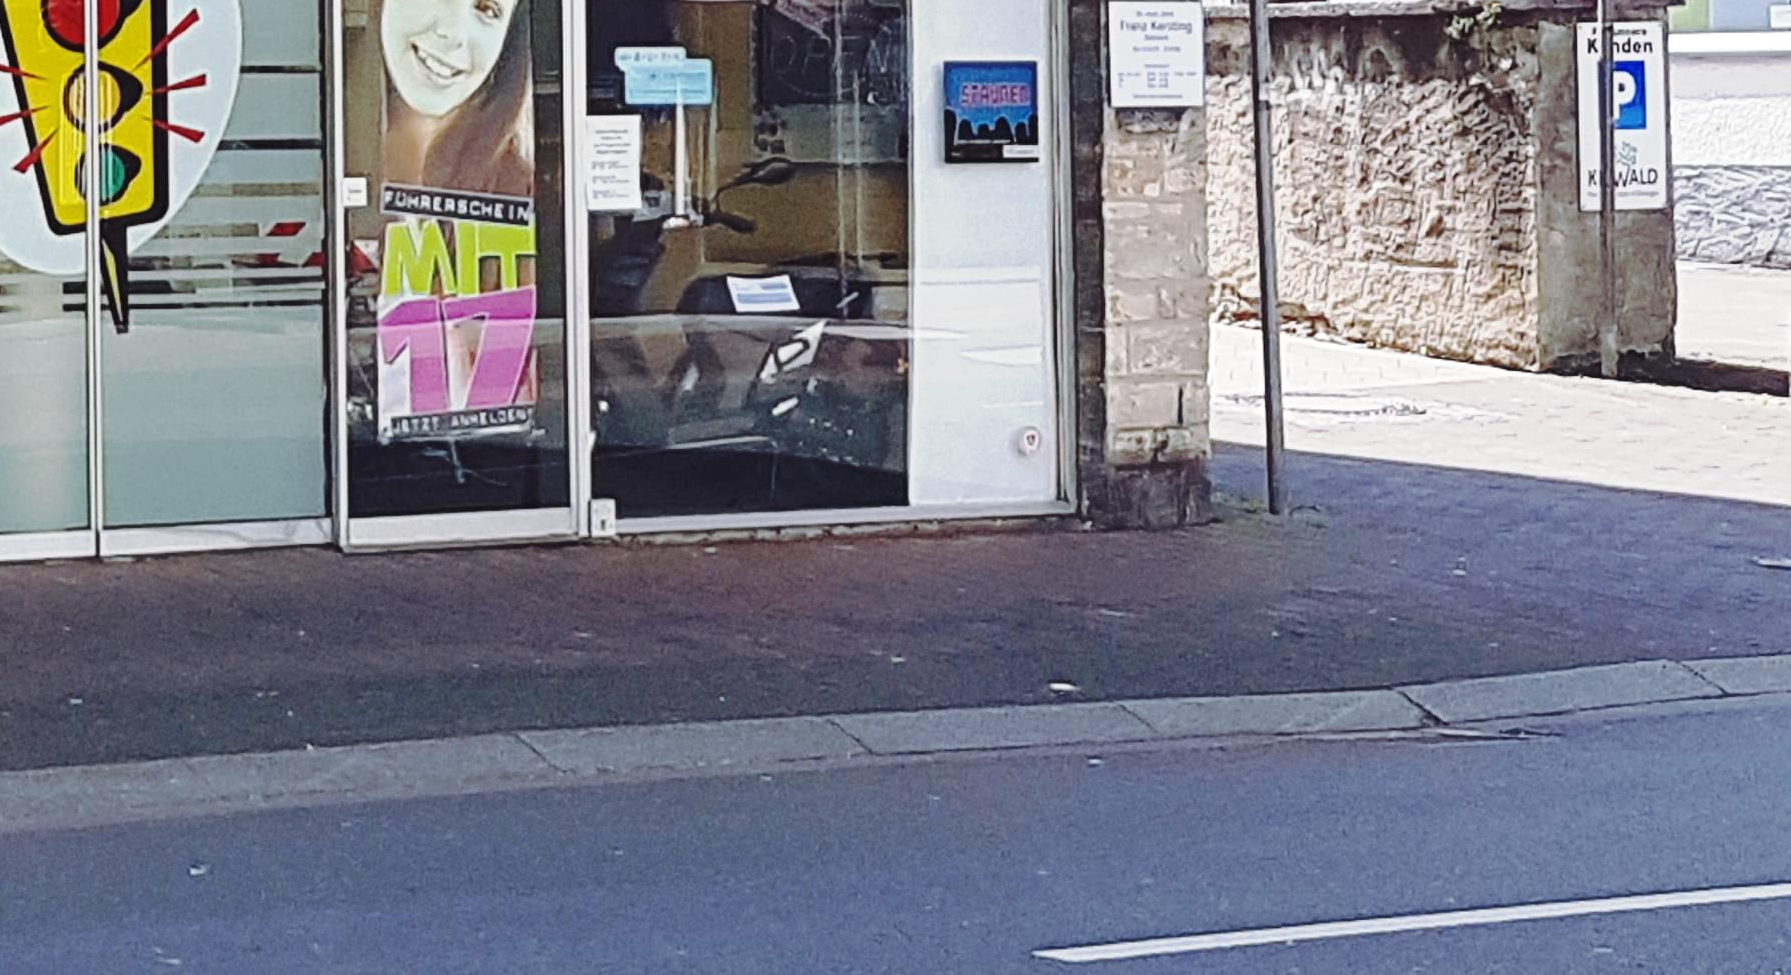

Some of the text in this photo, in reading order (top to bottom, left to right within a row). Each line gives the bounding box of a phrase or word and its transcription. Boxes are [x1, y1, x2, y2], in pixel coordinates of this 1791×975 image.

[1587, 37, 1653, 54] Knden
[384, 188, 532, 221] FÜHRERSCHEIN
[385, 219, 537, 296] MIT
[378, 287, 537, 414] 17
